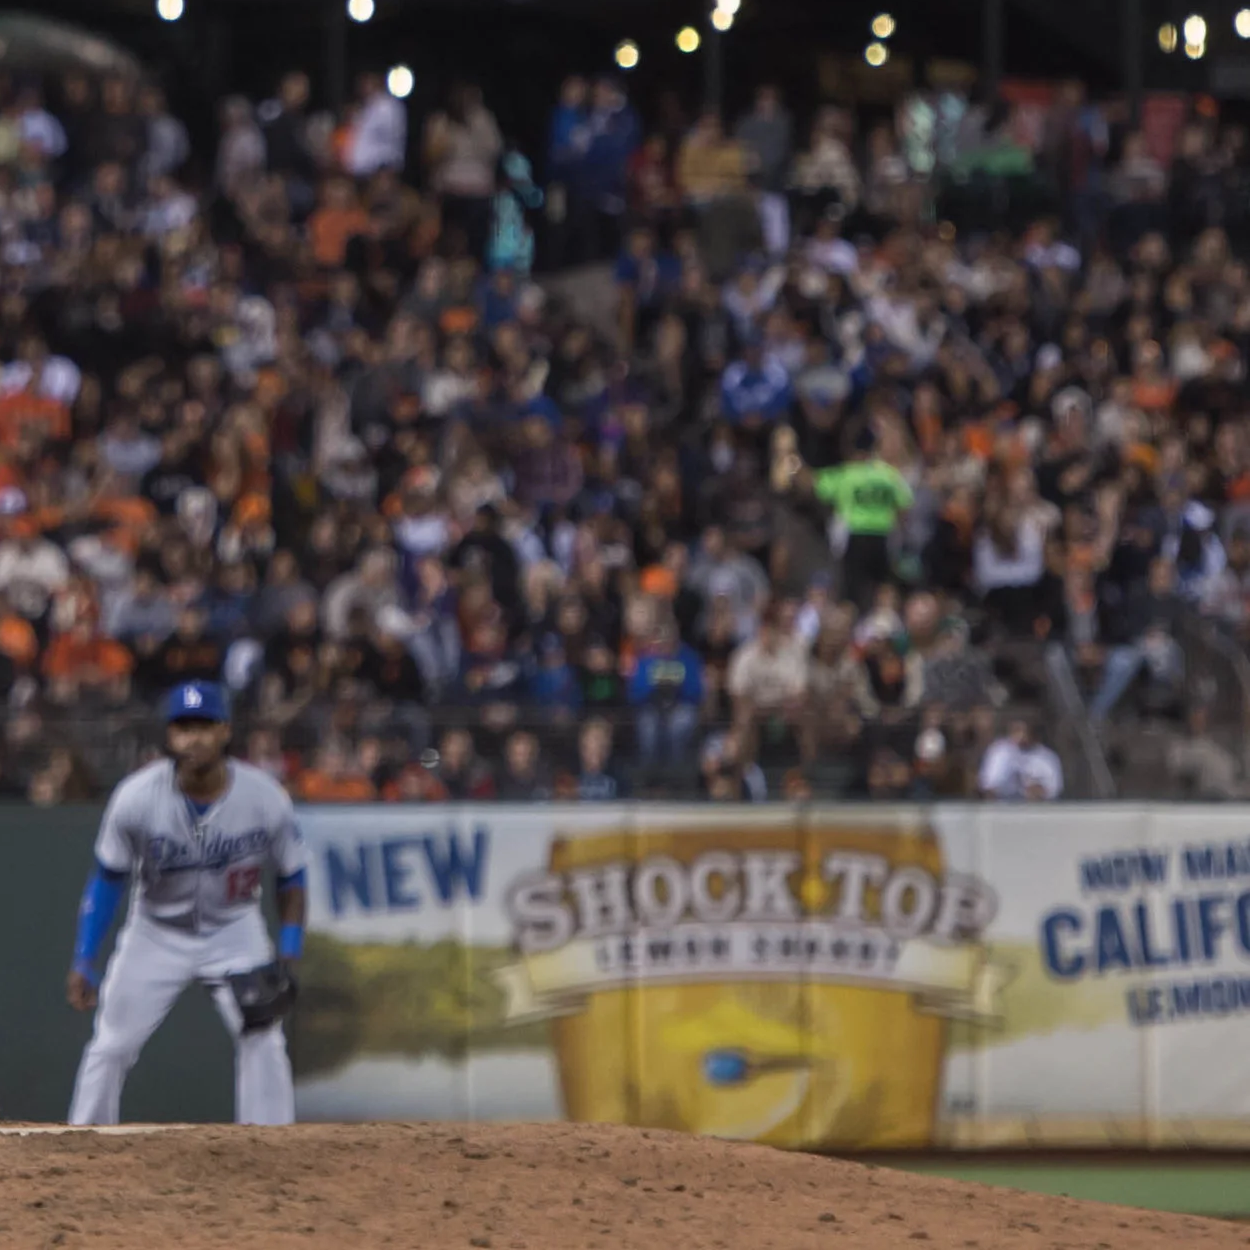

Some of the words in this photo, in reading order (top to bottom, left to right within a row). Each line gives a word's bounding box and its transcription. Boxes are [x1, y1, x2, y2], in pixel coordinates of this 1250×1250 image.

[325, 825, 491, 915] NEW
[510, 852, 801, 950] SHOCK
[824, 852, 997, 939] TOP
